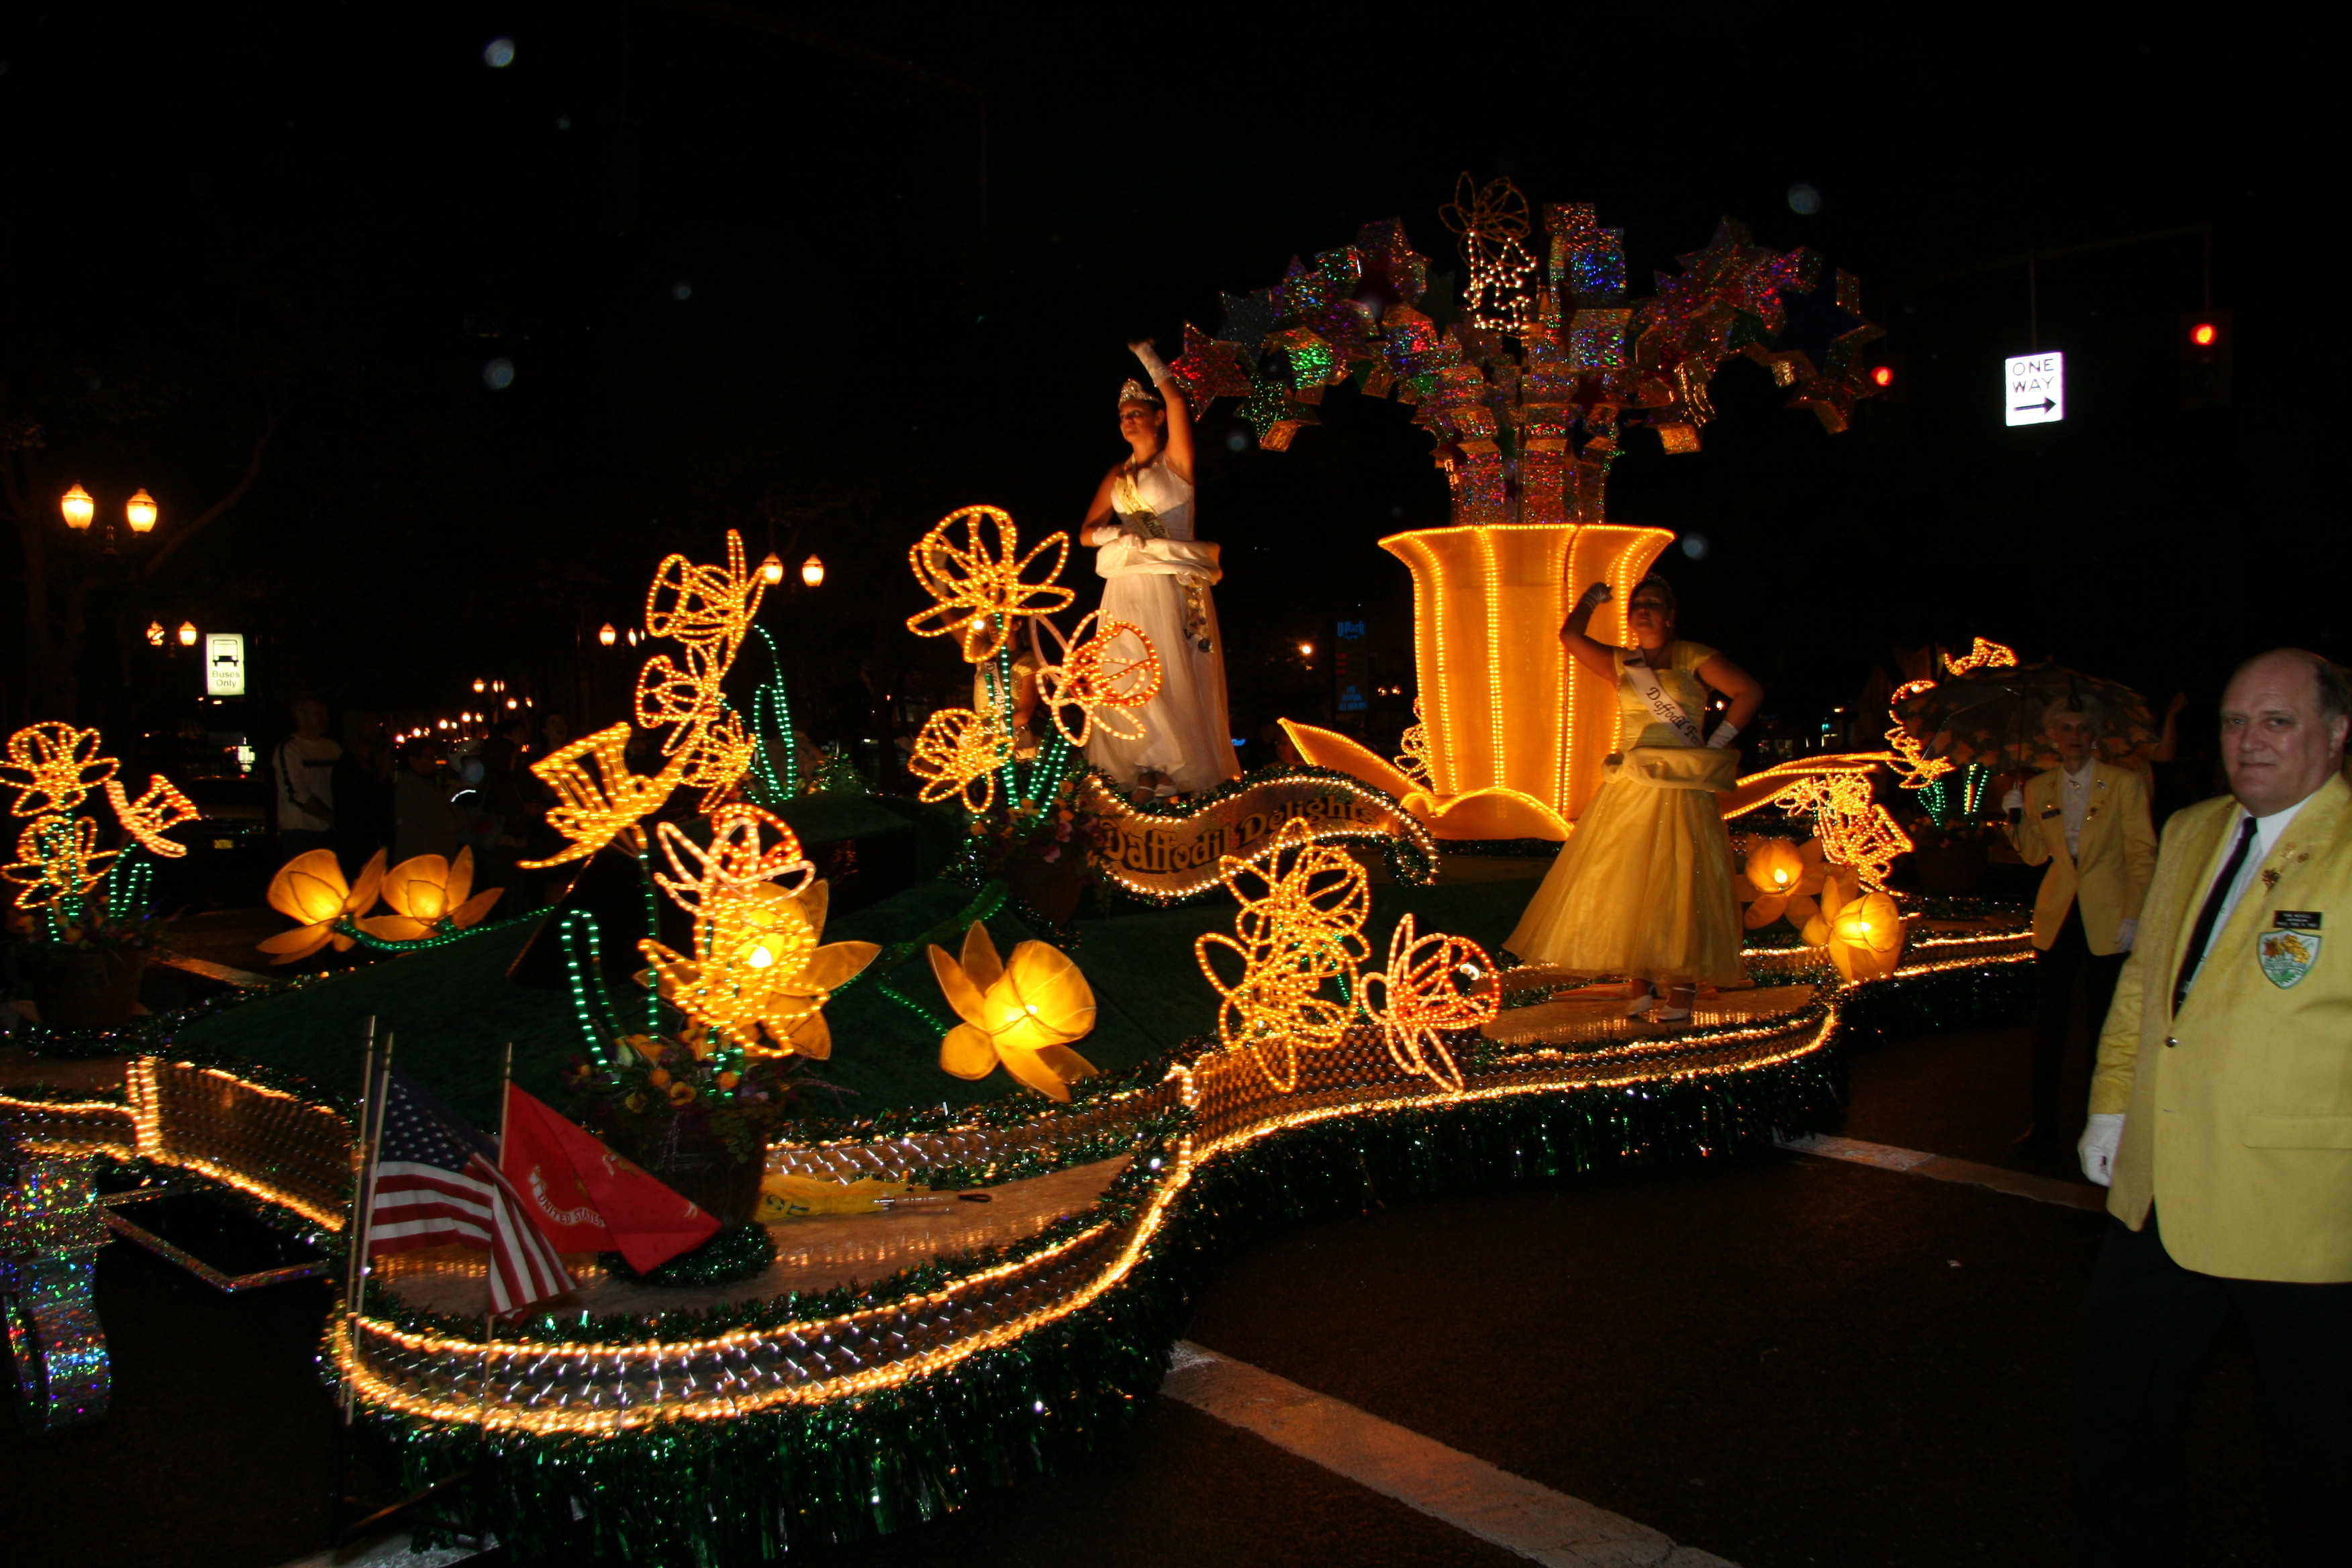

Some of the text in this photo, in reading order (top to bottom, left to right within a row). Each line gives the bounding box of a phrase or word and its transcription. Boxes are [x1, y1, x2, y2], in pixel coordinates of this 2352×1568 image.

[2013, 358, 2054, 376] ONE
[2012, 377, 2054, 393] WAY
[216, 679, 236, 689] Only
[1646, 687, 1689, 730] Daffodil
[1099, 795, 1379, 873] Daffodil Delights
[538, 1193, 603, 1226] UNITED STATES
